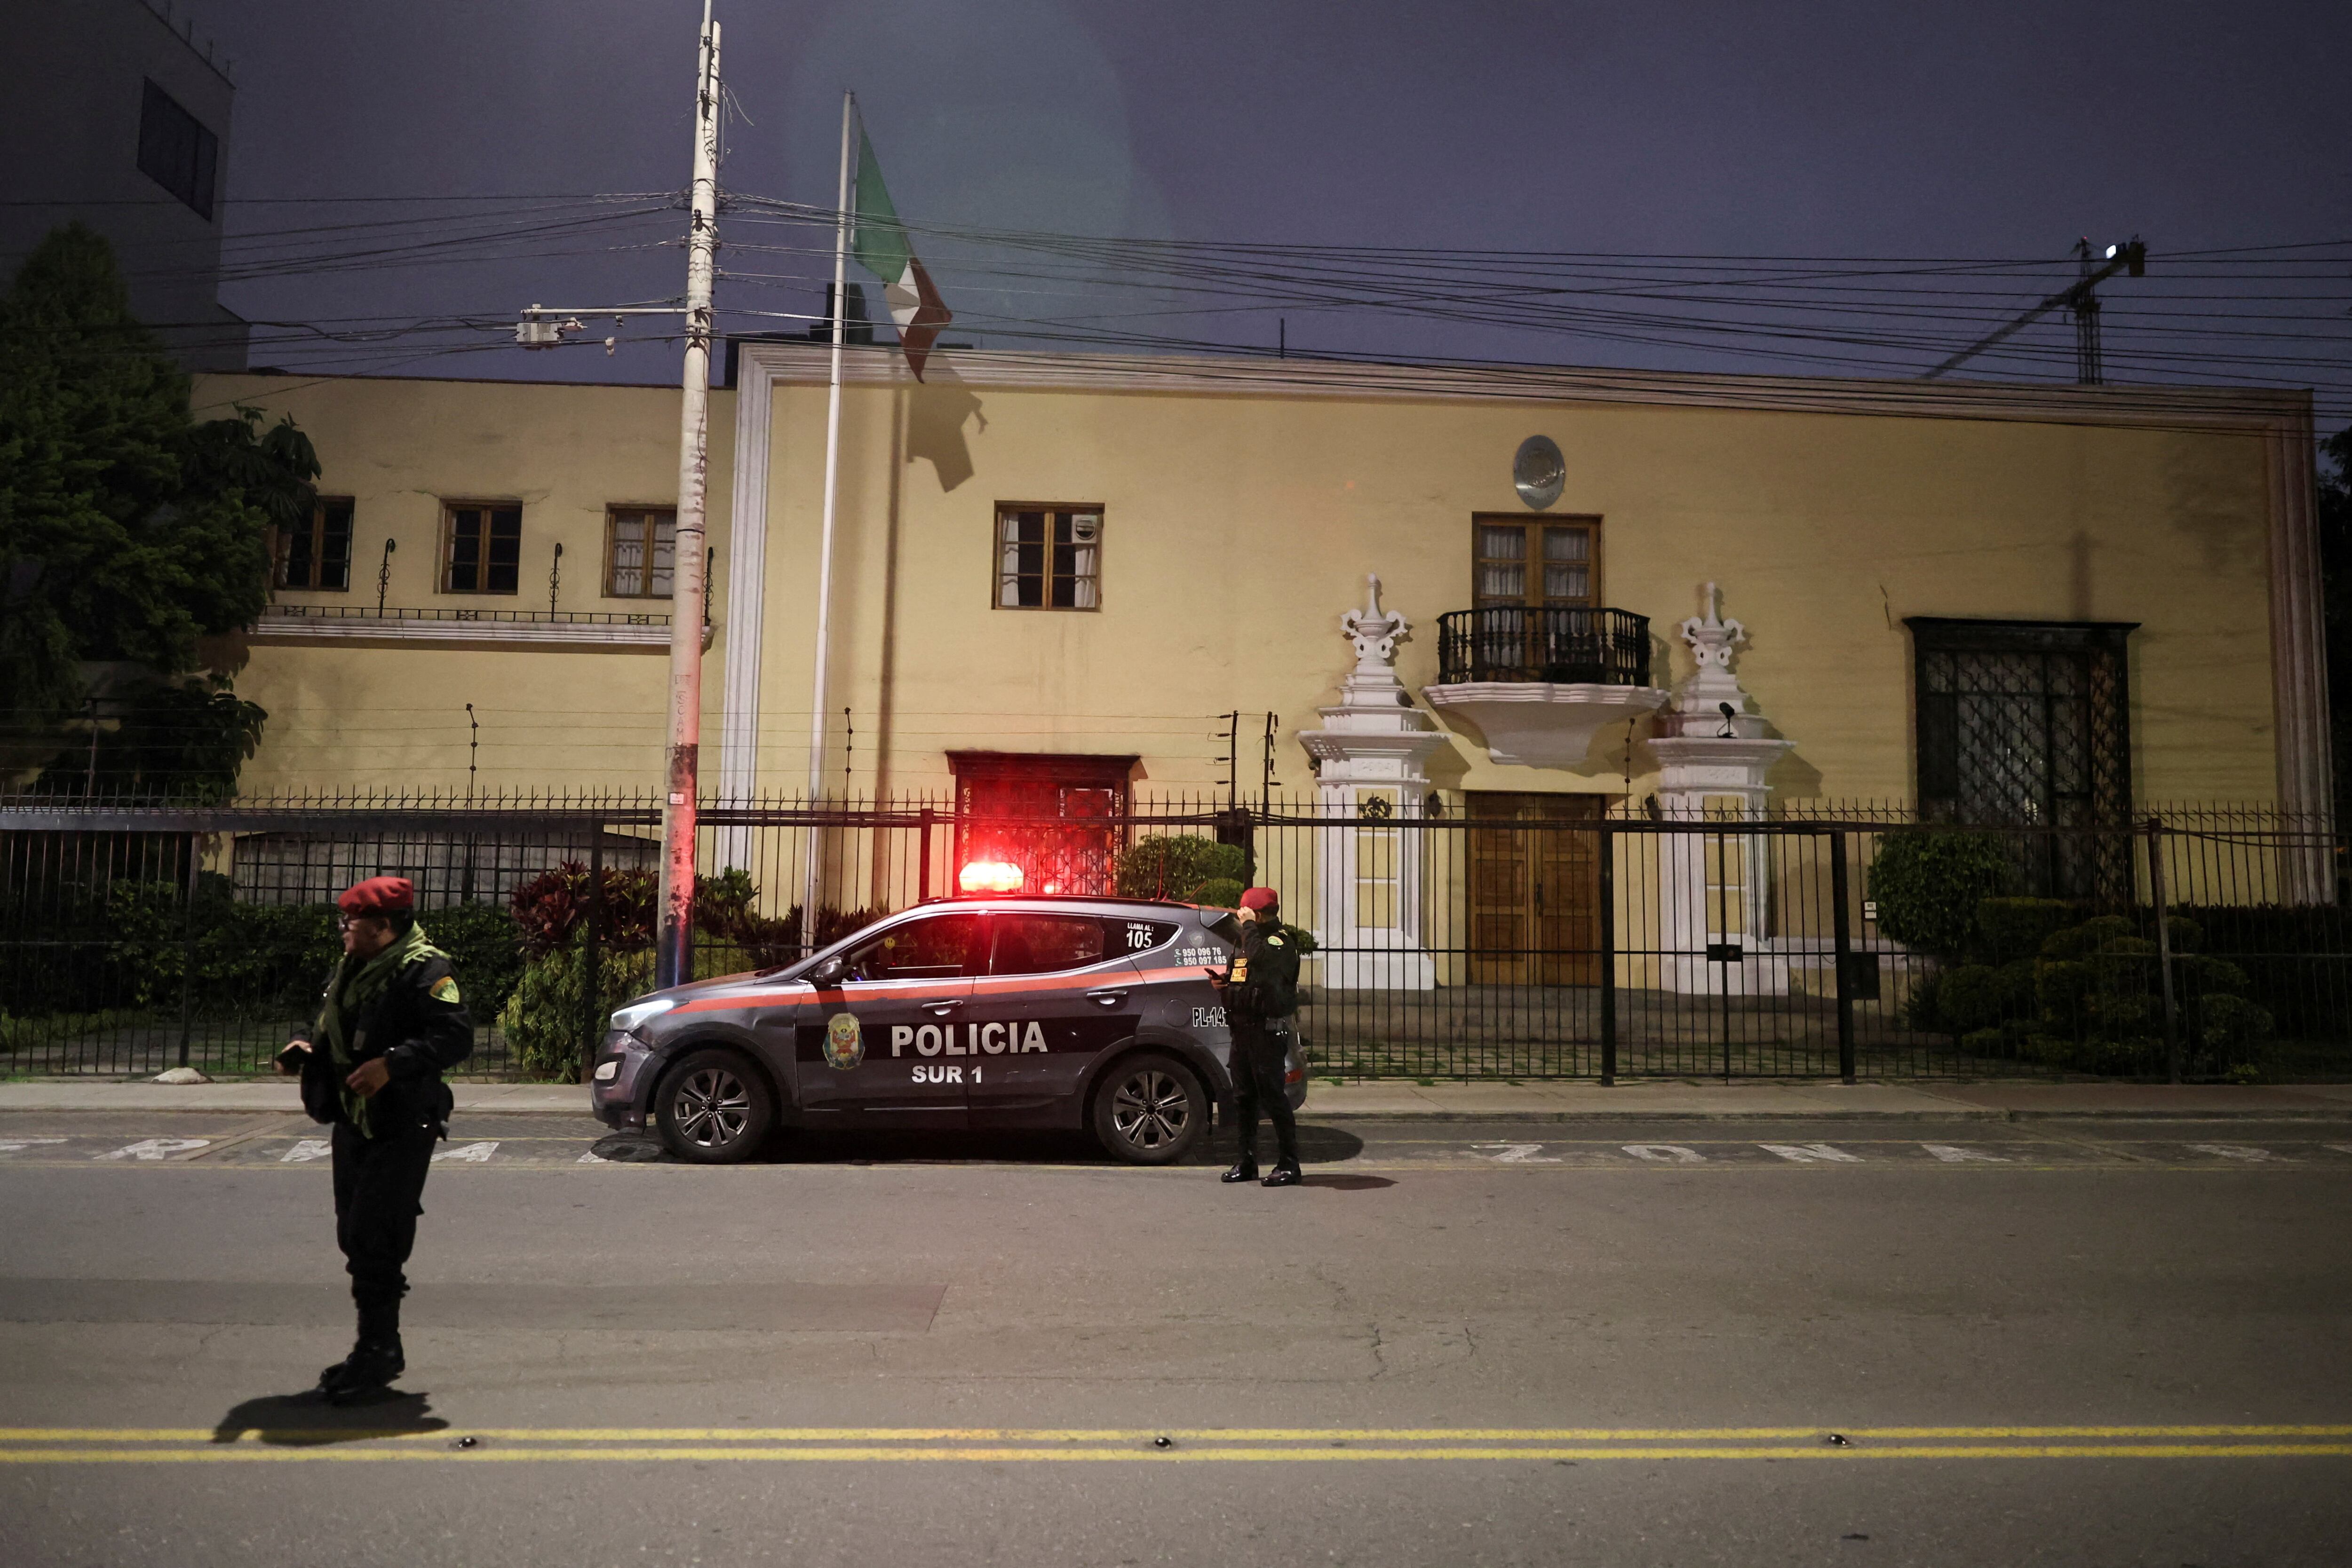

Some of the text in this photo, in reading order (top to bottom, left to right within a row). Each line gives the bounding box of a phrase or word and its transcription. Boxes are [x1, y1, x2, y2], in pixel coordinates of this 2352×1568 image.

[1127, 922, 1143, 930] LLAMA
[1126, 930, 1152, 948] 105
[1182, 948, 1196, 957] 950
[1198, 947, 1211, 956] 096
[1184, 957, 1197, 966] 950
[1199, 956, 1211, 965] 097
[1213, 956, 1227, 964] 185
[892, 1022, 1049, 1057] POLICIA
[912, 1065, 982, 1084] SUR 1
